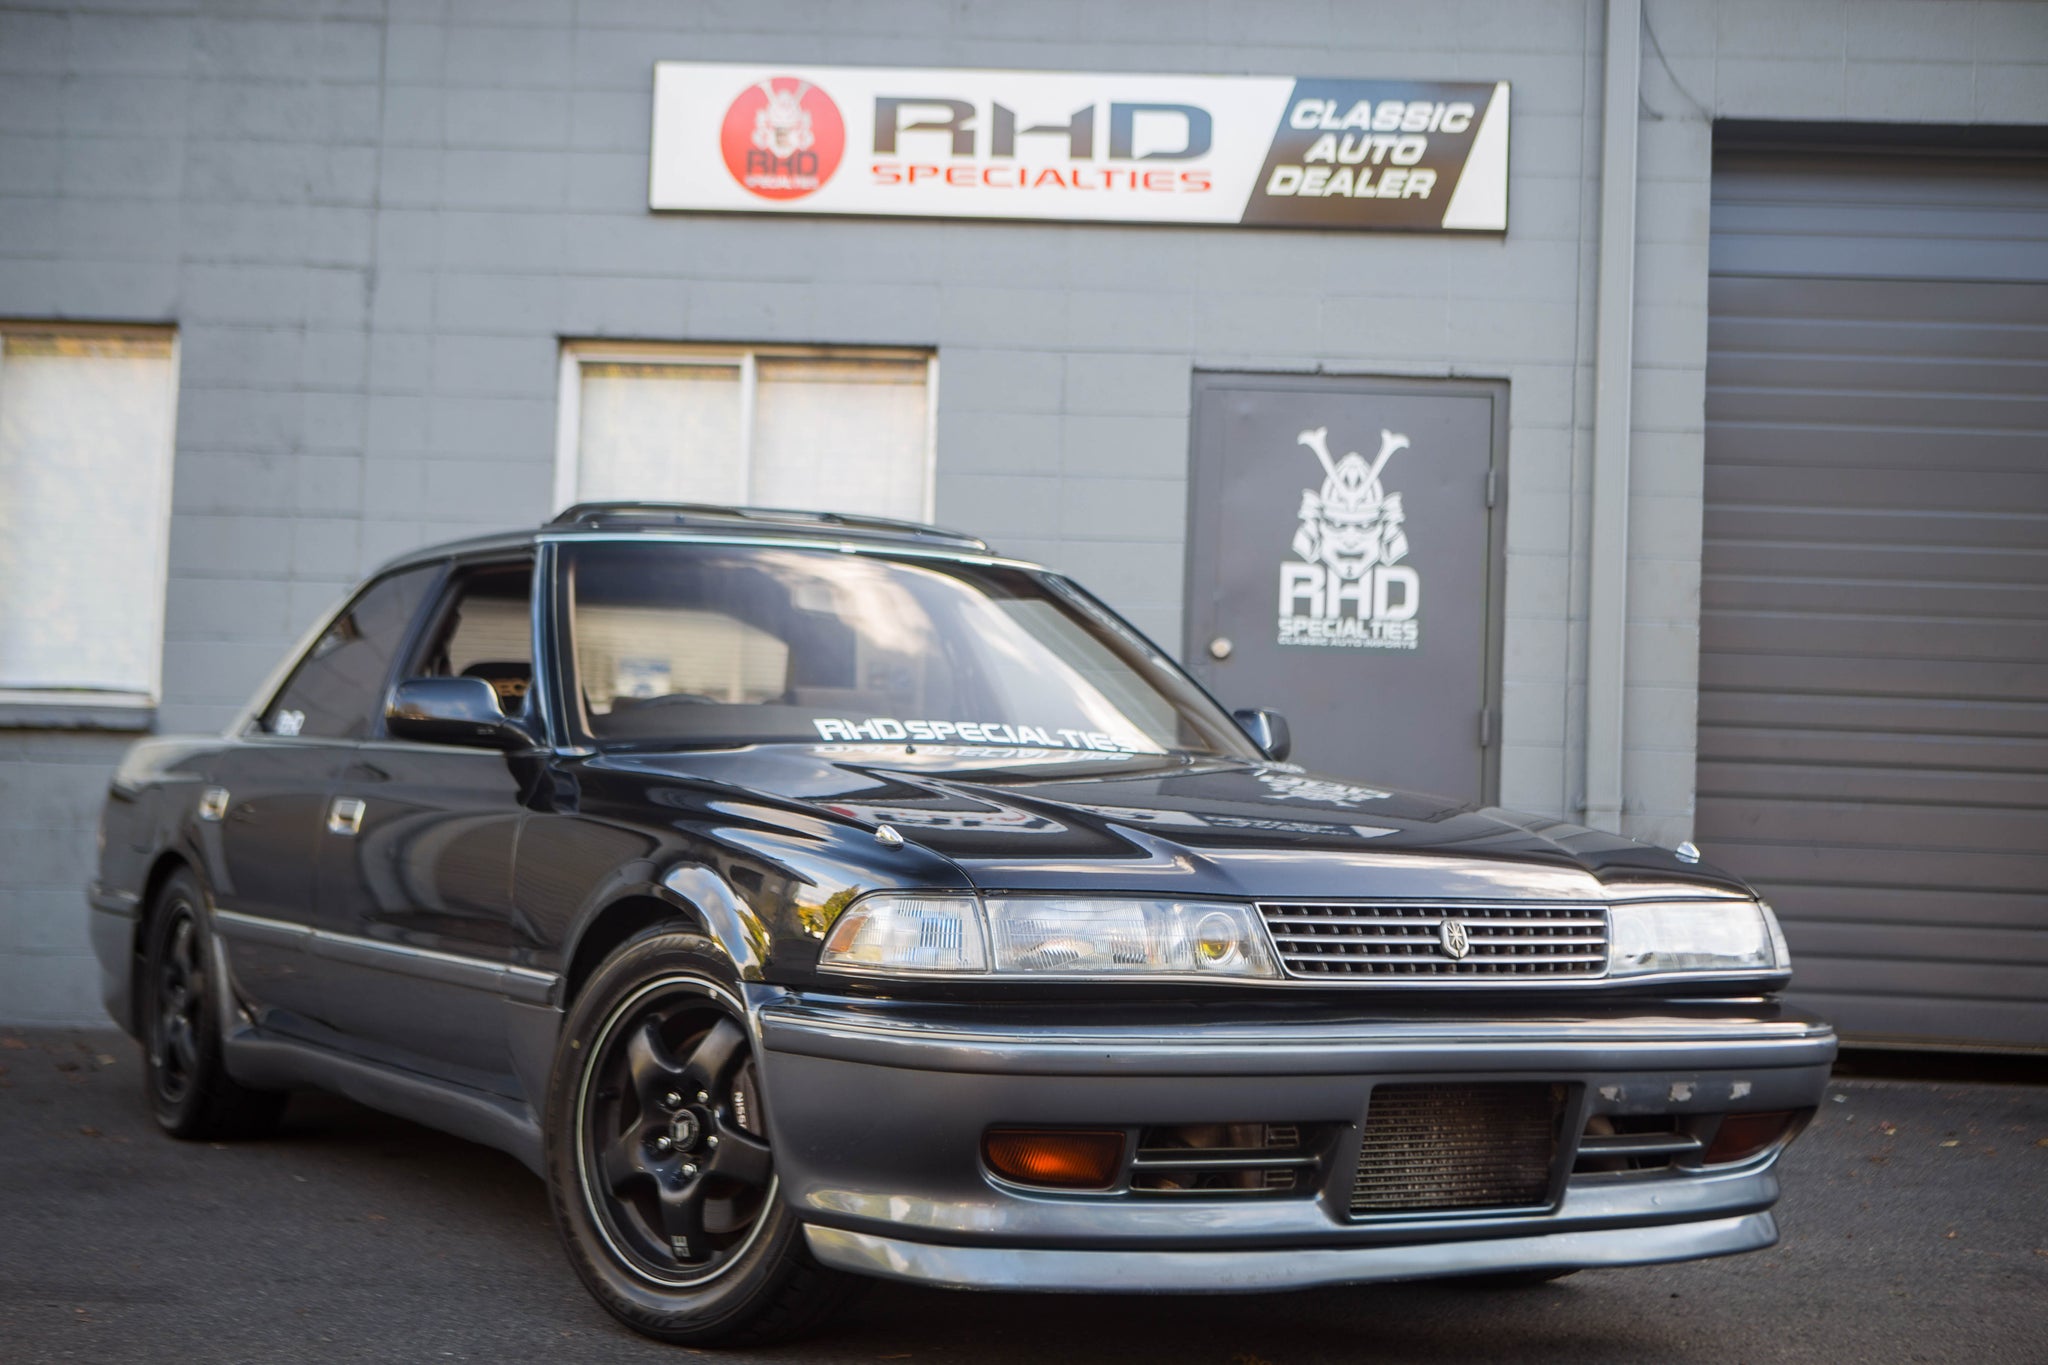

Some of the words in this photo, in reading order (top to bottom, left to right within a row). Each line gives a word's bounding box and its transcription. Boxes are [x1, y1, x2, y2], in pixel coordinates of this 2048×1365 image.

[873, 96, 1212, 161] RHD
[1289, 98, 1475, 133] CLASSIC
[746, 150, 819, 177] RHD
[1303, 133, 1428, 166] AUTO
[871, 164, 1213, 193] SPECIALTIES
[1265, 164, 1438, 200] DEALER
[1278, 560, 1420, 621] RHD
[1278, 615, 1419, 642] SPECIALTIES
